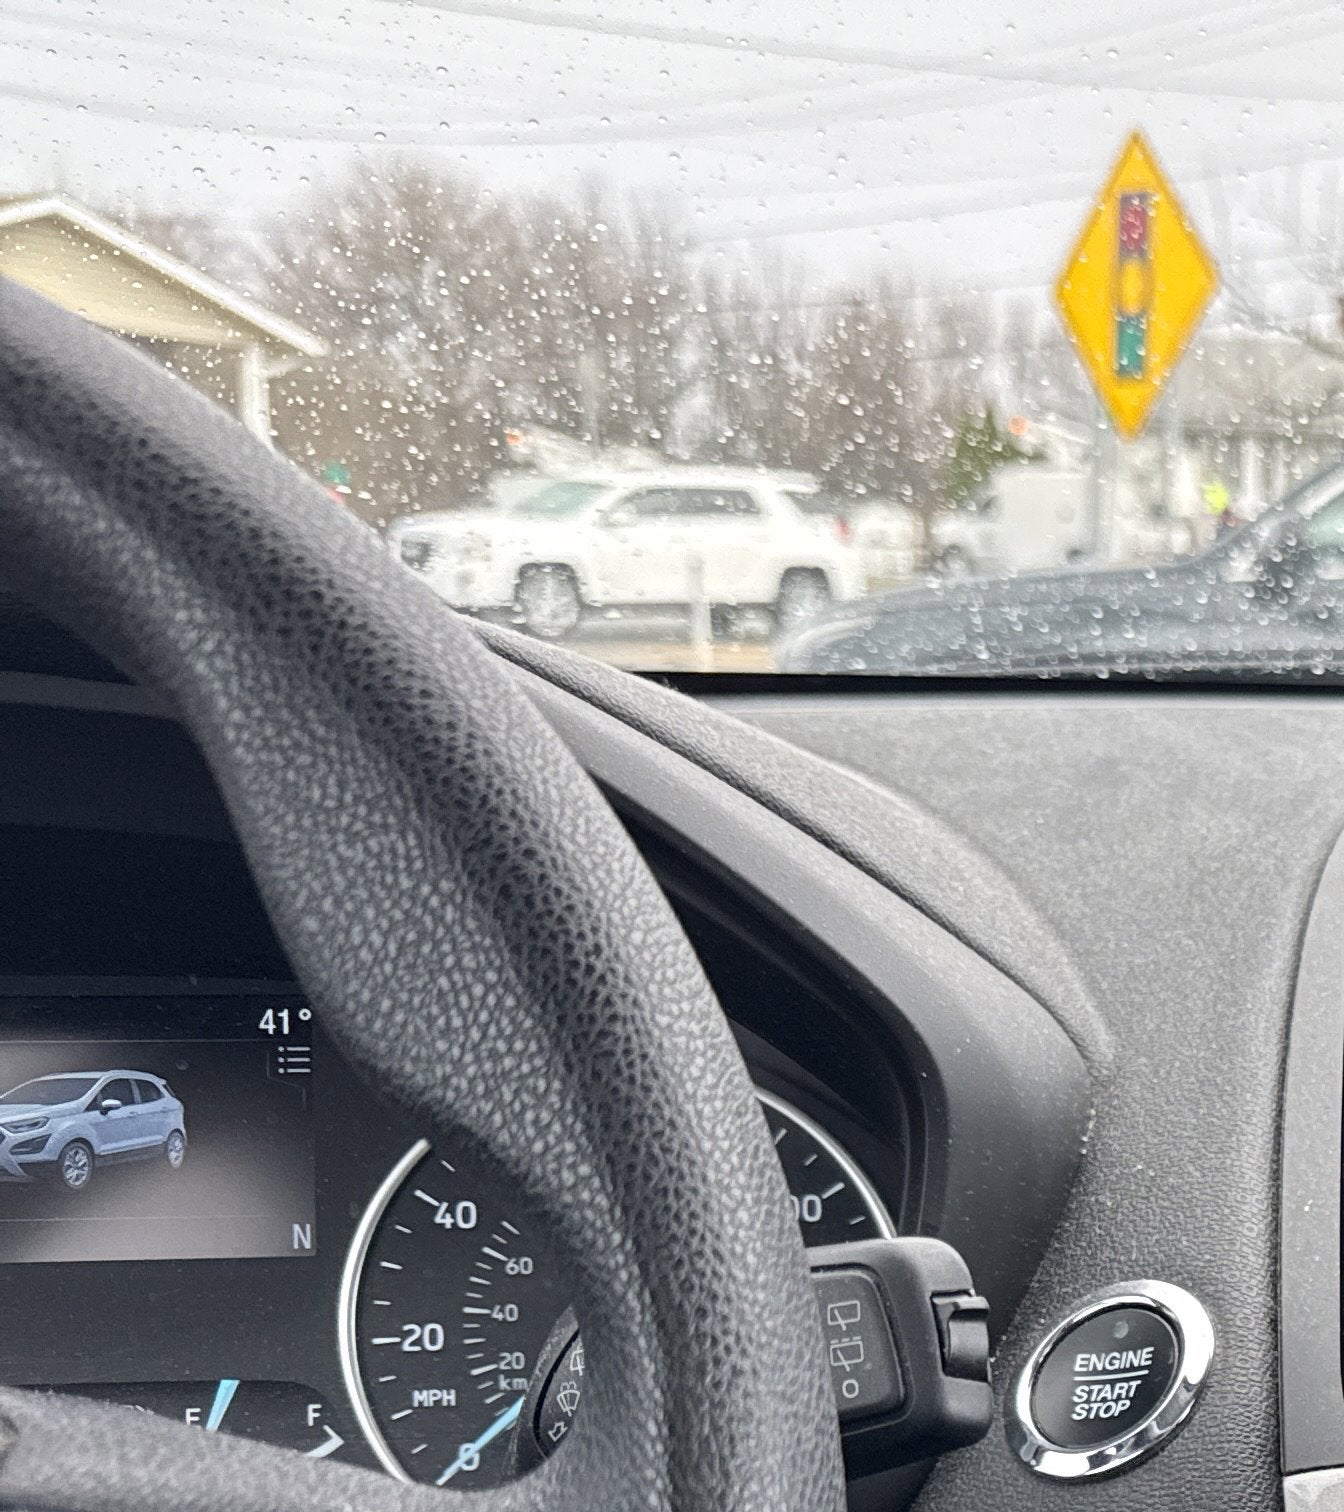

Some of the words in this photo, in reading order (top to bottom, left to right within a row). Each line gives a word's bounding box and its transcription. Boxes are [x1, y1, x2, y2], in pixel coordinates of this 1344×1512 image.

[434, 1200, 478, 1229] 40
[292, 1224, 312, 1250] N
[505, 1256, 533, 1275] 60
[491, 1304, 518, 1322] 40
[402, 1323, 444, 1351] 20
[499, 1351, 526, 1370] 20
[1074, 1346, 1155, 1372] ENGINE
[499, 1374, 528, 1391] km
[1072, 1380, 1142, 1403] START
[413, 1388, 456, 1408] MPH
[307, 1404, 323, 1427] F
[1071, 1399, 1131, 1421] STOP
